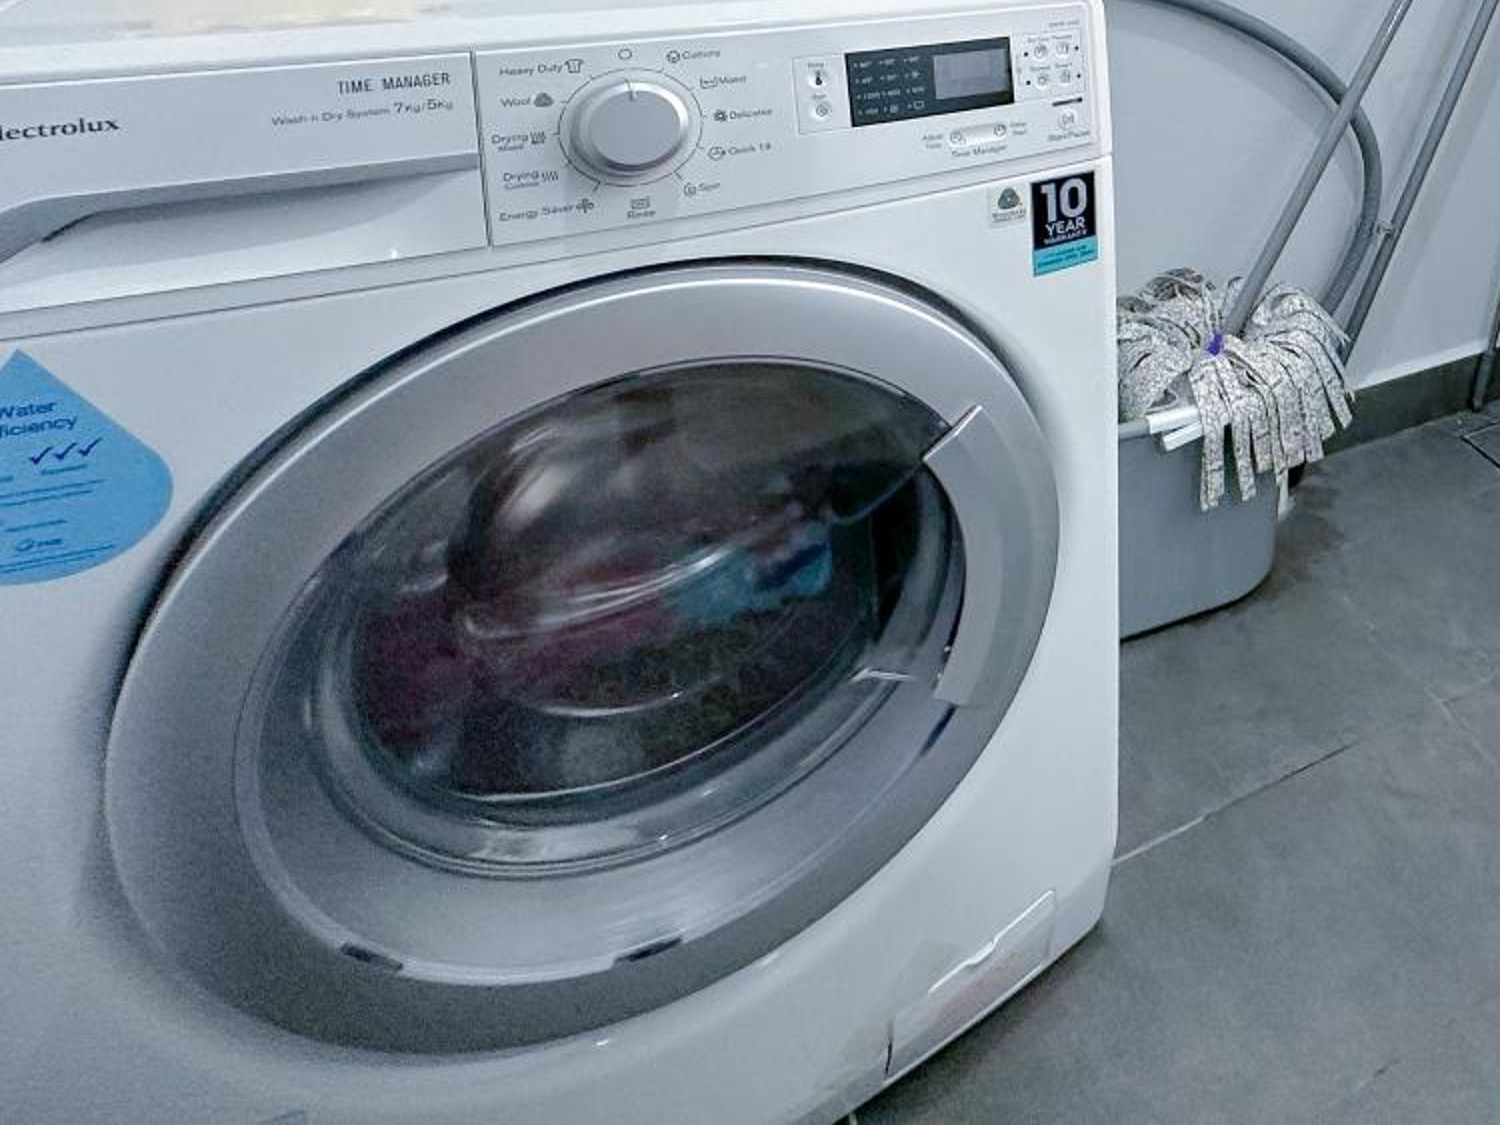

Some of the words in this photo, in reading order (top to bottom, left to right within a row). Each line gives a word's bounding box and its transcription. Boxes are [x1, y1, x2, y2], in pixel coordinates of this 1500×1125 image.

[537, 63, 563, 74] Duty
[338, 79, 373, 95] TIME
[383, 72, 451, 90] MANAGER
[500, 96, 531, 107] Wool
[1041, 177, 1087, 223] 10
[1044, 216, 1086, 236] YEAR
